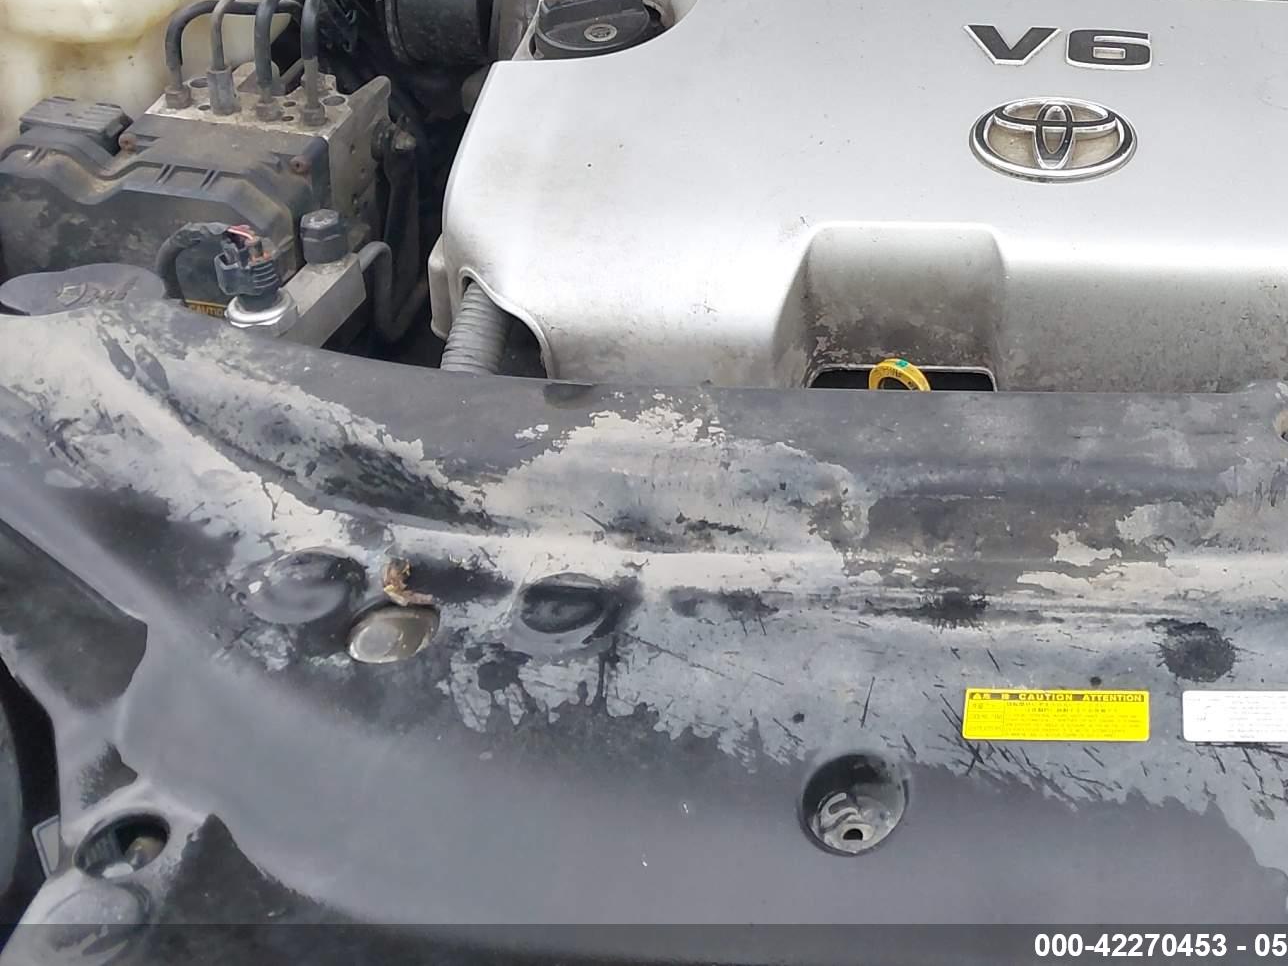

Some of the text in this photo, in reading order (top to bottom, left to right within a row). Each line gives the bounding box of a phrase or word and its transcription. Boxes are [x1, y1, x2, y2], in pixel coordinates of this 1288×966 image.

[962, 23, 1152, 70] V6
[1018, 693, 1073, 702] CAUTION
[1082, 694, 1142, 703] ATTENTION
